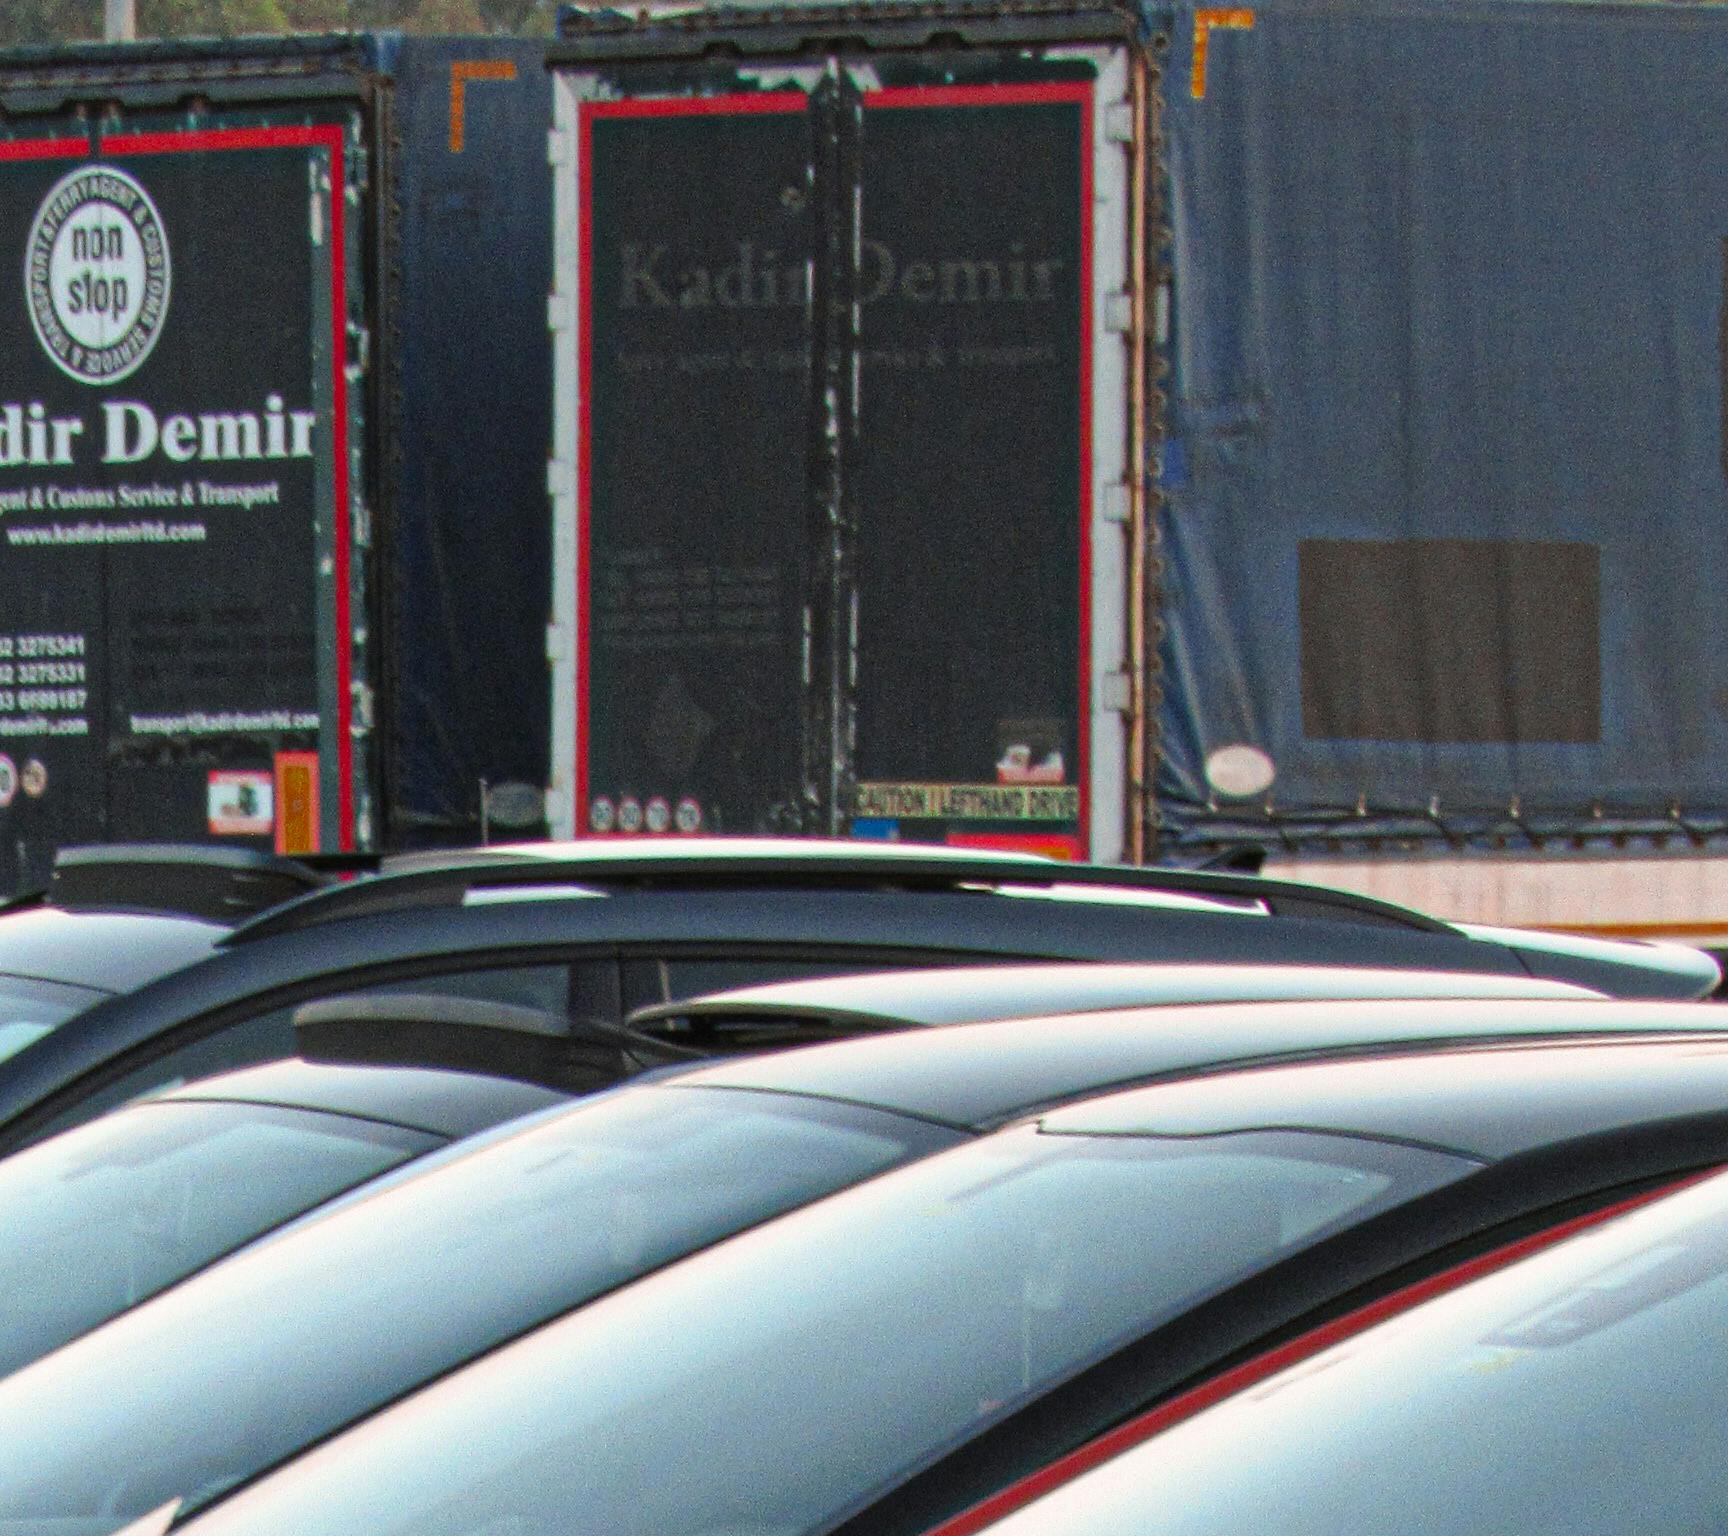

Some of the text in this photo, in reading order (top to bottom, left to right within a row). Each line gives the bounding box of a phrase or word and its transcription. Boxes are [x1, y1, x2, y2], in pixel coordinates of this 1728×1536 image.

[73, 225, 122, 261] non
[68, 268, 128, 322] stop
[100, 393, 316, 463] Demir
[30, 485, 44, 510] &
[47, 484, 116, 510] Customs
[118, 481, 179, 508] Service
[181, 480, 195, 507] &
[198, 480, 280, 510] Transport
